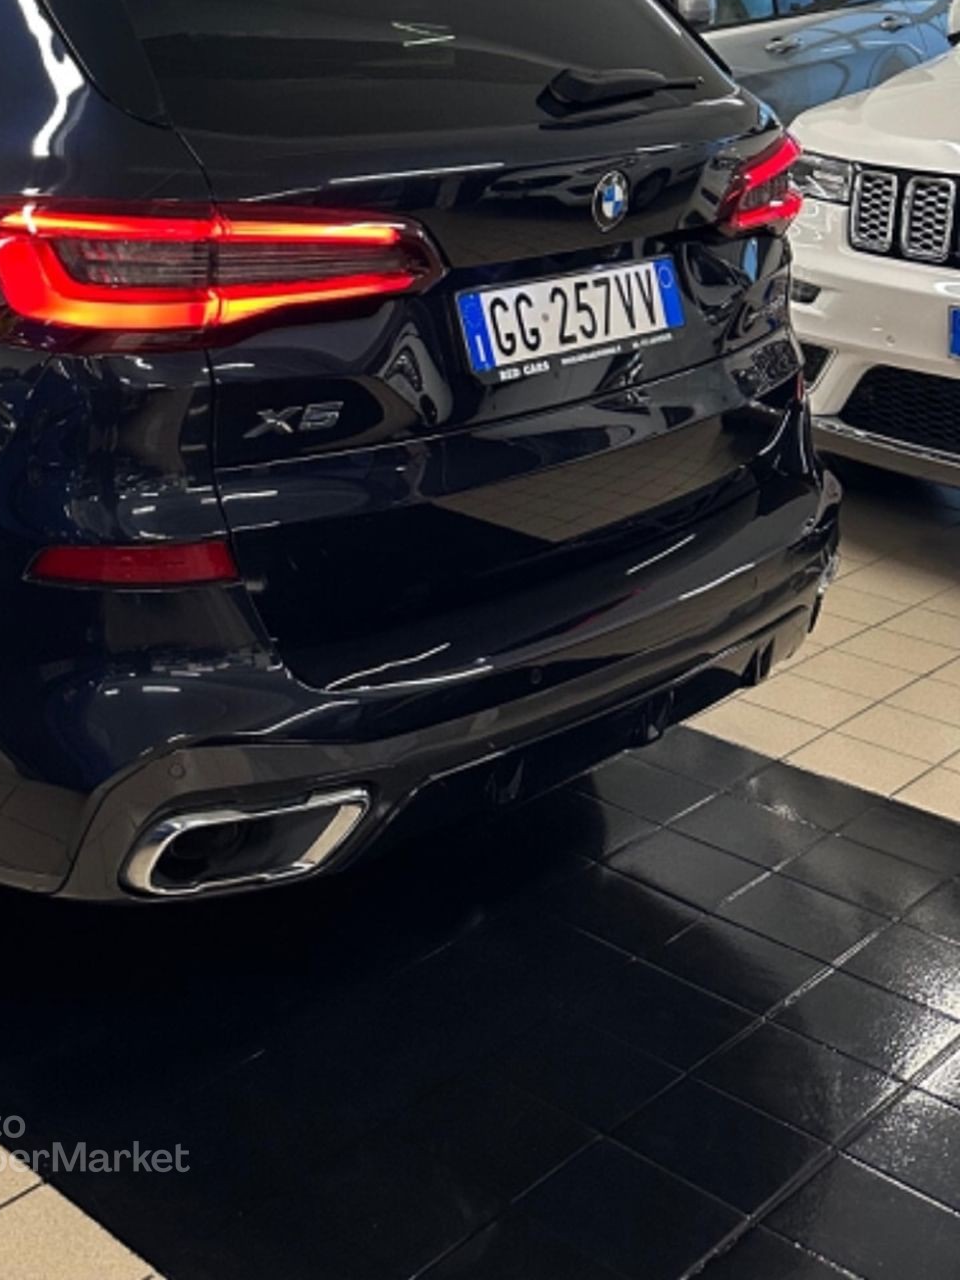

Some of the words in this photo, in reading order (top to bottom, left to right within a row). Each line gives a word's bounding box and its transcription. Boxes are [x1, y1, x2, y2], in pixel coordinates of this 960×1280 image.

[490, 293, 541, 356] GG
[550, 269, 658, 345] 257VV
[243, 401, 344, 438] X5
